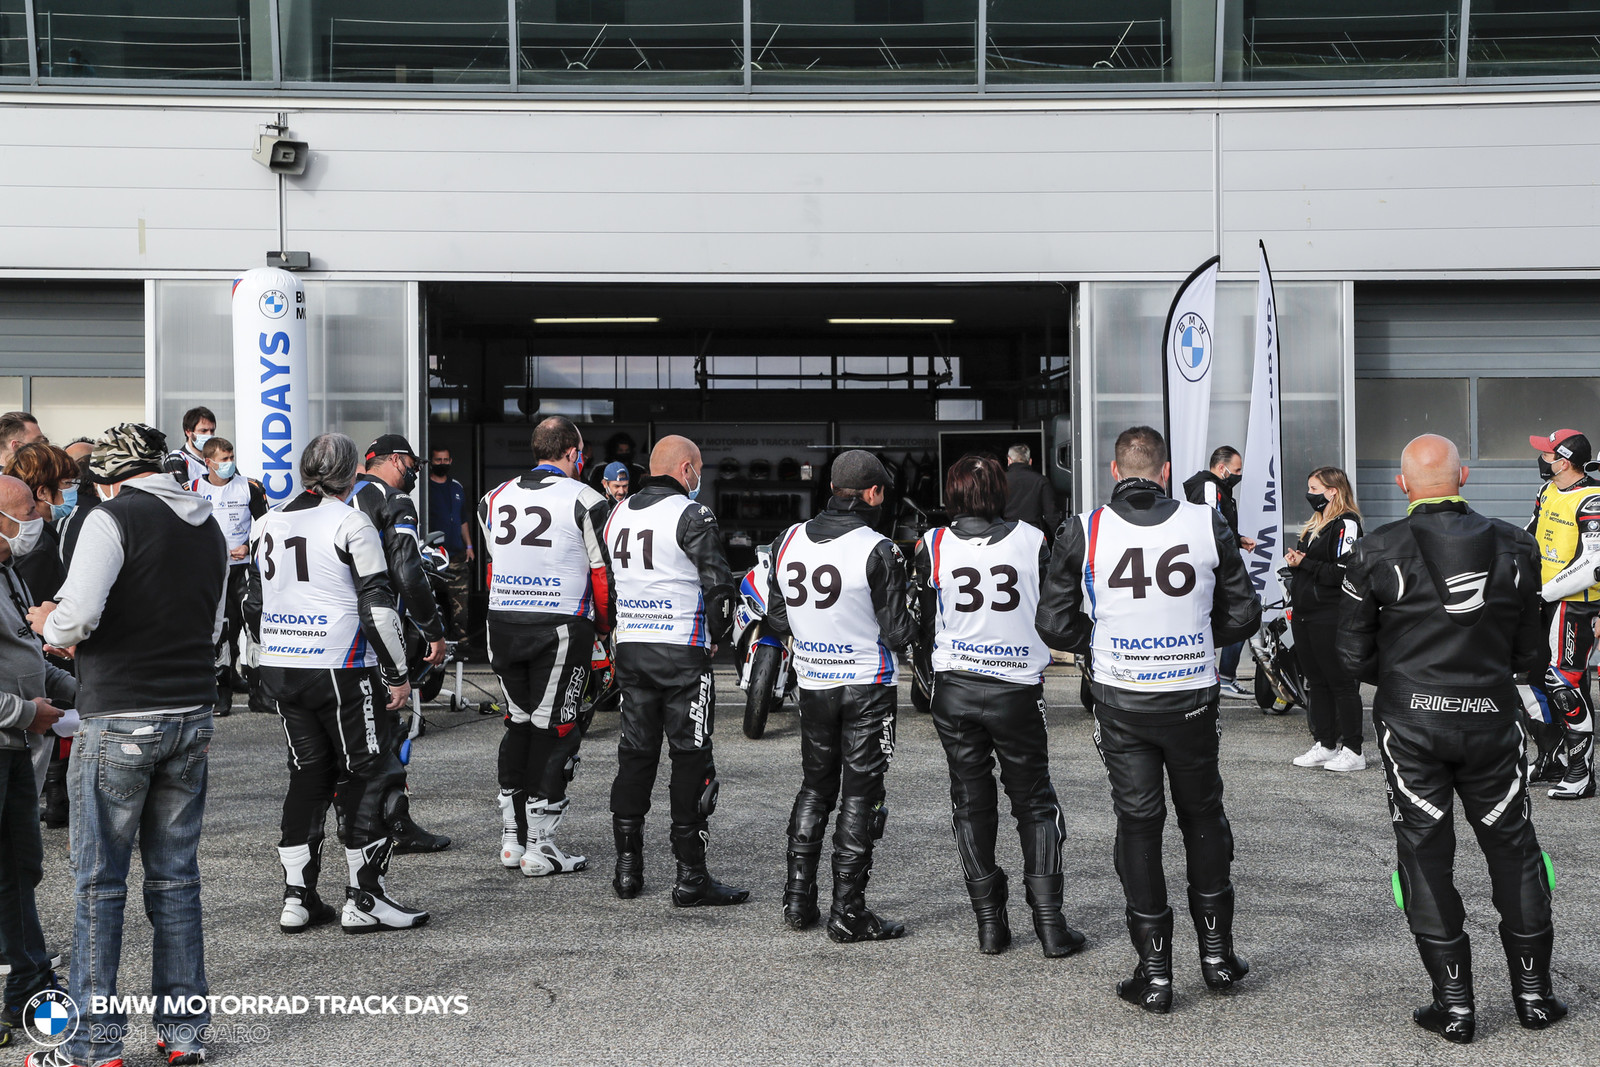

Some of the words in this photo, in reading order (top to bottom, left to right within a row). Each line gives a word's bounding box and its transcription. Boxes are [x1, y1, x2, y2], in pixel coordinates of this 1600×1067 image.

[1178, 316, 1207, 335] BMW
[259, 331, 294, 506] CKDAYS
[706, 438, 758, 446] MOTORRAD
[761, 438, 790, 446] TRACK
[791, 438, 815, 446] DAYS
[890, 438, 939, 446] MOTORRA
[495, 504, 552, 548] 32
[264, 532, 310, 582] 31
[613, 527, 655, 570] 41
[1107, 543, 1197, 600] 46
[1555, 572, 1569, 584] BMW
[1568, 559, 1590, 577] Motorrad
[493, 574, 561, 587] TRACKDAYS
[785, 562, 842, 609] 39
[951, 564, 1021, 613] 33
[512, 589, 561, 597] MOTORRAD
[501, 600, 560, 608] MICHELIN
[617, 599, 673, 610] RACKDAYS
[280, 629, 327, 637] MOTORRAD
[626, 623, 674, 631] MICHELIN
[951, 639, 1030, 657] TRACKDAYS
[1110, 632, 1205, 650] TRACKDAYS
[1565, 621, 1576, 666] RST
[267, 645, 326, 655] MICHELIN
[1153, 651, 1206, 661] MOTORRAD
[811, 657, 856, 665] MOTORRAD
[960, 655, 981, 664] BMW
[981, 659, 1028, 669] MOTORRAD
[805, 670, 856, 679] MICHELIN
[1136, 664, 1206, 681] MICHELIN
[1410, 693, 1499, 713] RICHA
